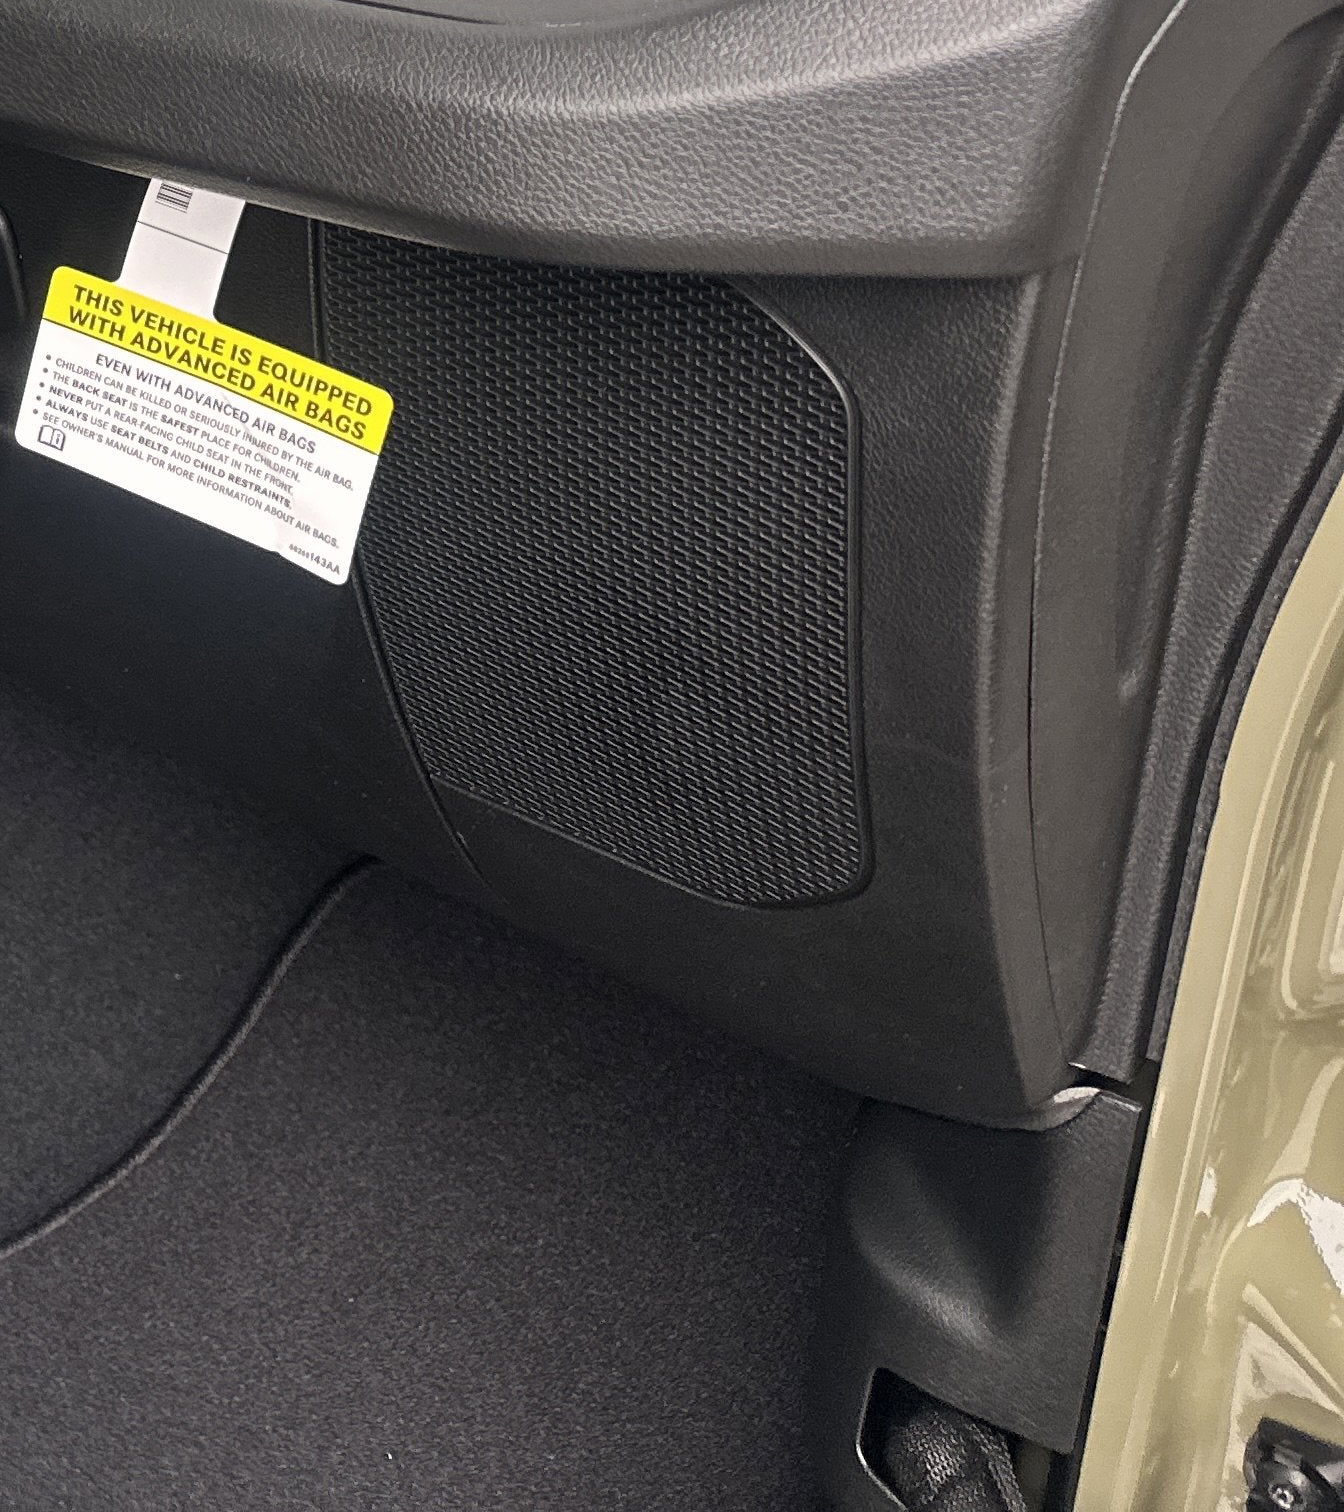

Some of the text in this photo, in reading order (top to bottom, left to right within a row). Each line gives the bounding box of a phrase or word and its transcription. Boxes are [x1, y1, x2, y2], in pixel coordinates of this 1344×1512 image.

[68, 305, 366, 441] WITH ADVANCED AIR BAGS
[73, 284, 372, 416] THIS VEHICLE IS EQUIPPED
[96, 353, 316, 454] EVEN WITH ADVANCED AIR BAGS
[42, 412, 339, 549] SEE OWNER'S MANUAL FOR MORE INFORMATION ABOUT AIR BAGS.
[45, 399, 293, 509] ALWAYS USE SEAT BELTS AND CHILD RESTRAINTS.
[49, 384, 83, 405] NEVER
[85, 398, 103, 413] PUT
[104, 407, 111, 417] A
[113, 410, 173, 442] REAR-FACING
[175, 435, 204, 454] CHILD
[205, 448, 230, 466] SEAT
[231, 458, 241, 470] IN
[245, 463, 262, 479] THE
[53, 371, 301, 483] THE BACK SEAT IS THE SAFEST PLACE FOR CHILDREN.
[55, 357, 353, 492] CHILDREN CAN BE KILLED OR SERIOUSLY INJURED BY THE AIR BAG.
